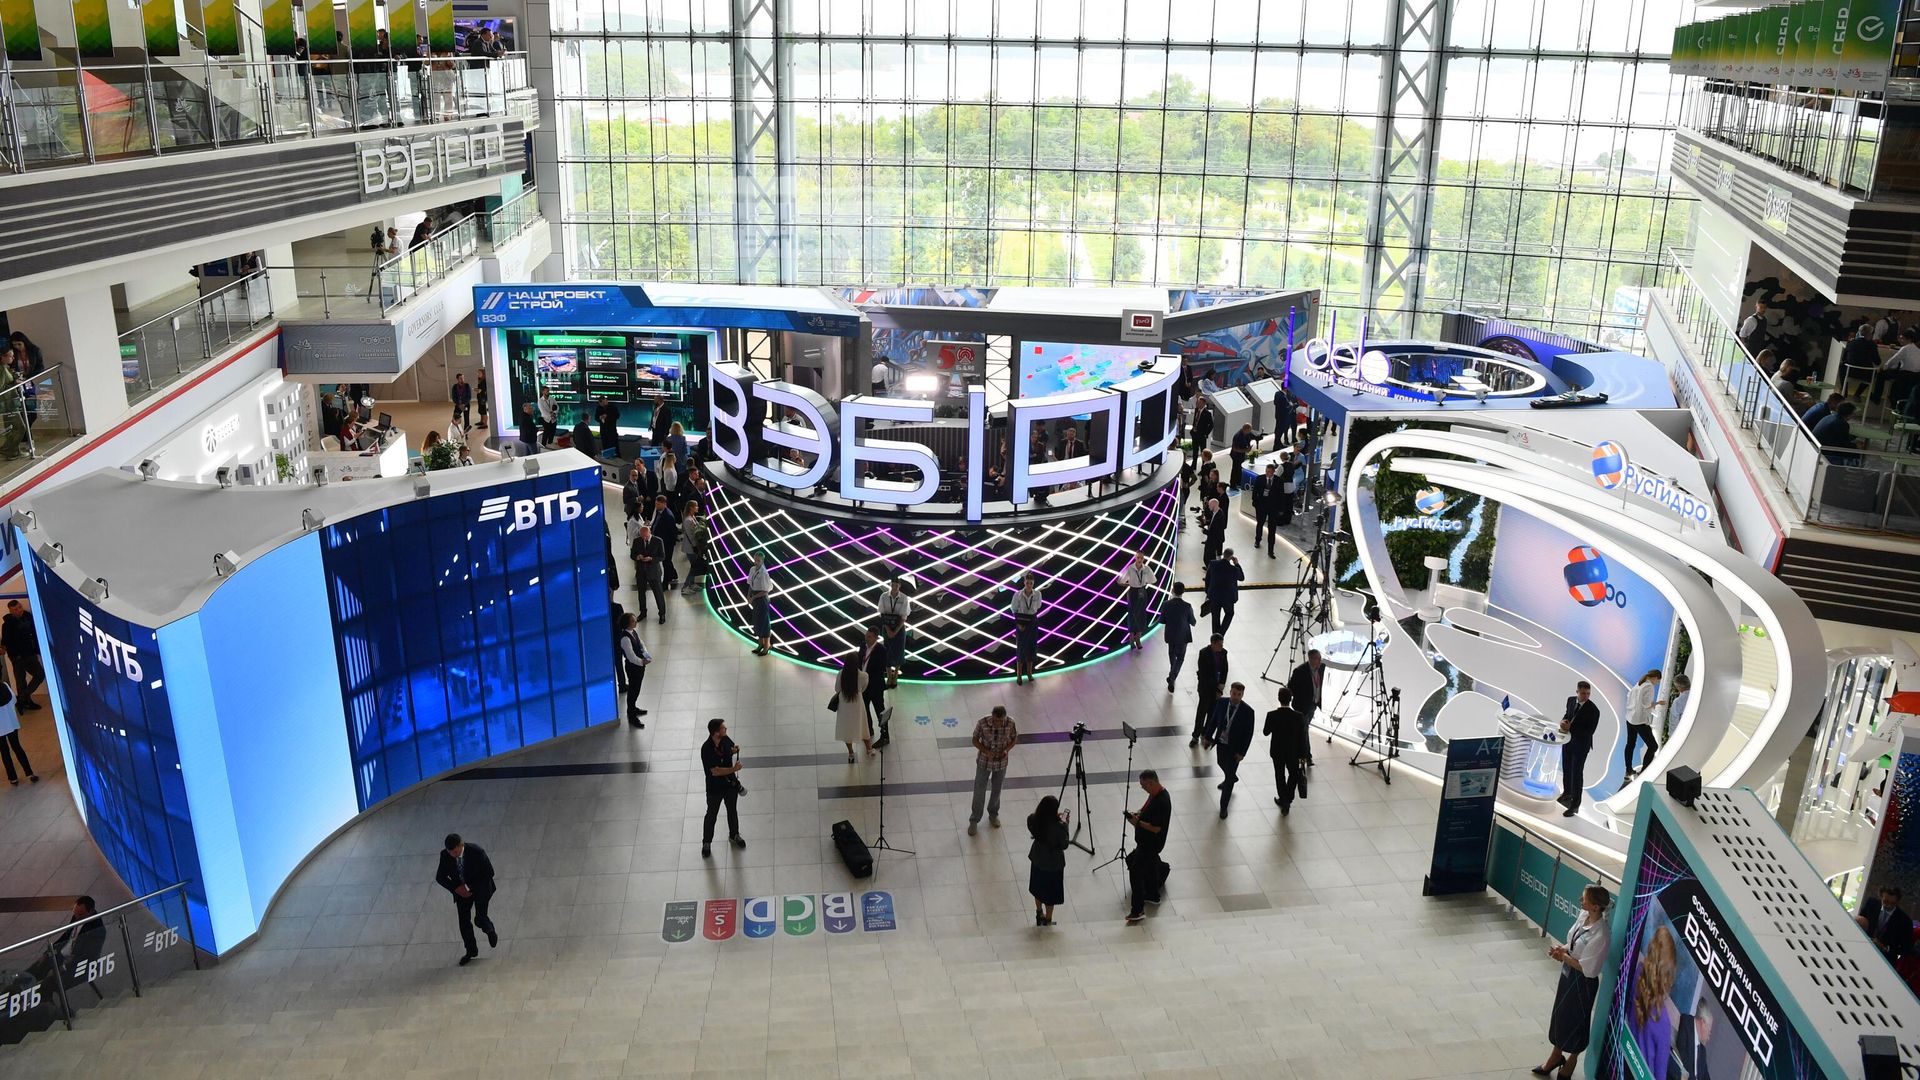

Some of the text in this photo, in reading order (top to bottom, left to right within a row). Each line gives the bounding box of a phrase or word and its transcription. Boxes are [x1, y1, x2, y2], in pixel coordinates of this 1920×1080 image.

[508, 290, 606, 300] НАЦПРОЕКТ
[509, 299, 564, 309] СТРОЙ
[1304, 310, 1391, 384] delo
[1303, 369, 1389, 397] ГРУППА КОМПАНИЙ
[1625, 465, 1708, 522] РусГидро
[514, 489, 582, 531] ВТБ
[1394, 516, 1463, 532] РусГидро
[94, 626, 144, 682] ВТБ
[744, 897, 775, 922] D
[786, 896, 813, 921] C
[823, 893, 853, 918] B
[715, 914, 725, 925] S
[155, 926, 179, 952] ВТБ
[87, 952, 115, 982] ВТБ
[9, 984, 42, 1018] ВТБ
[1752, 990, 1779, 1035] СТЕНДЕ
